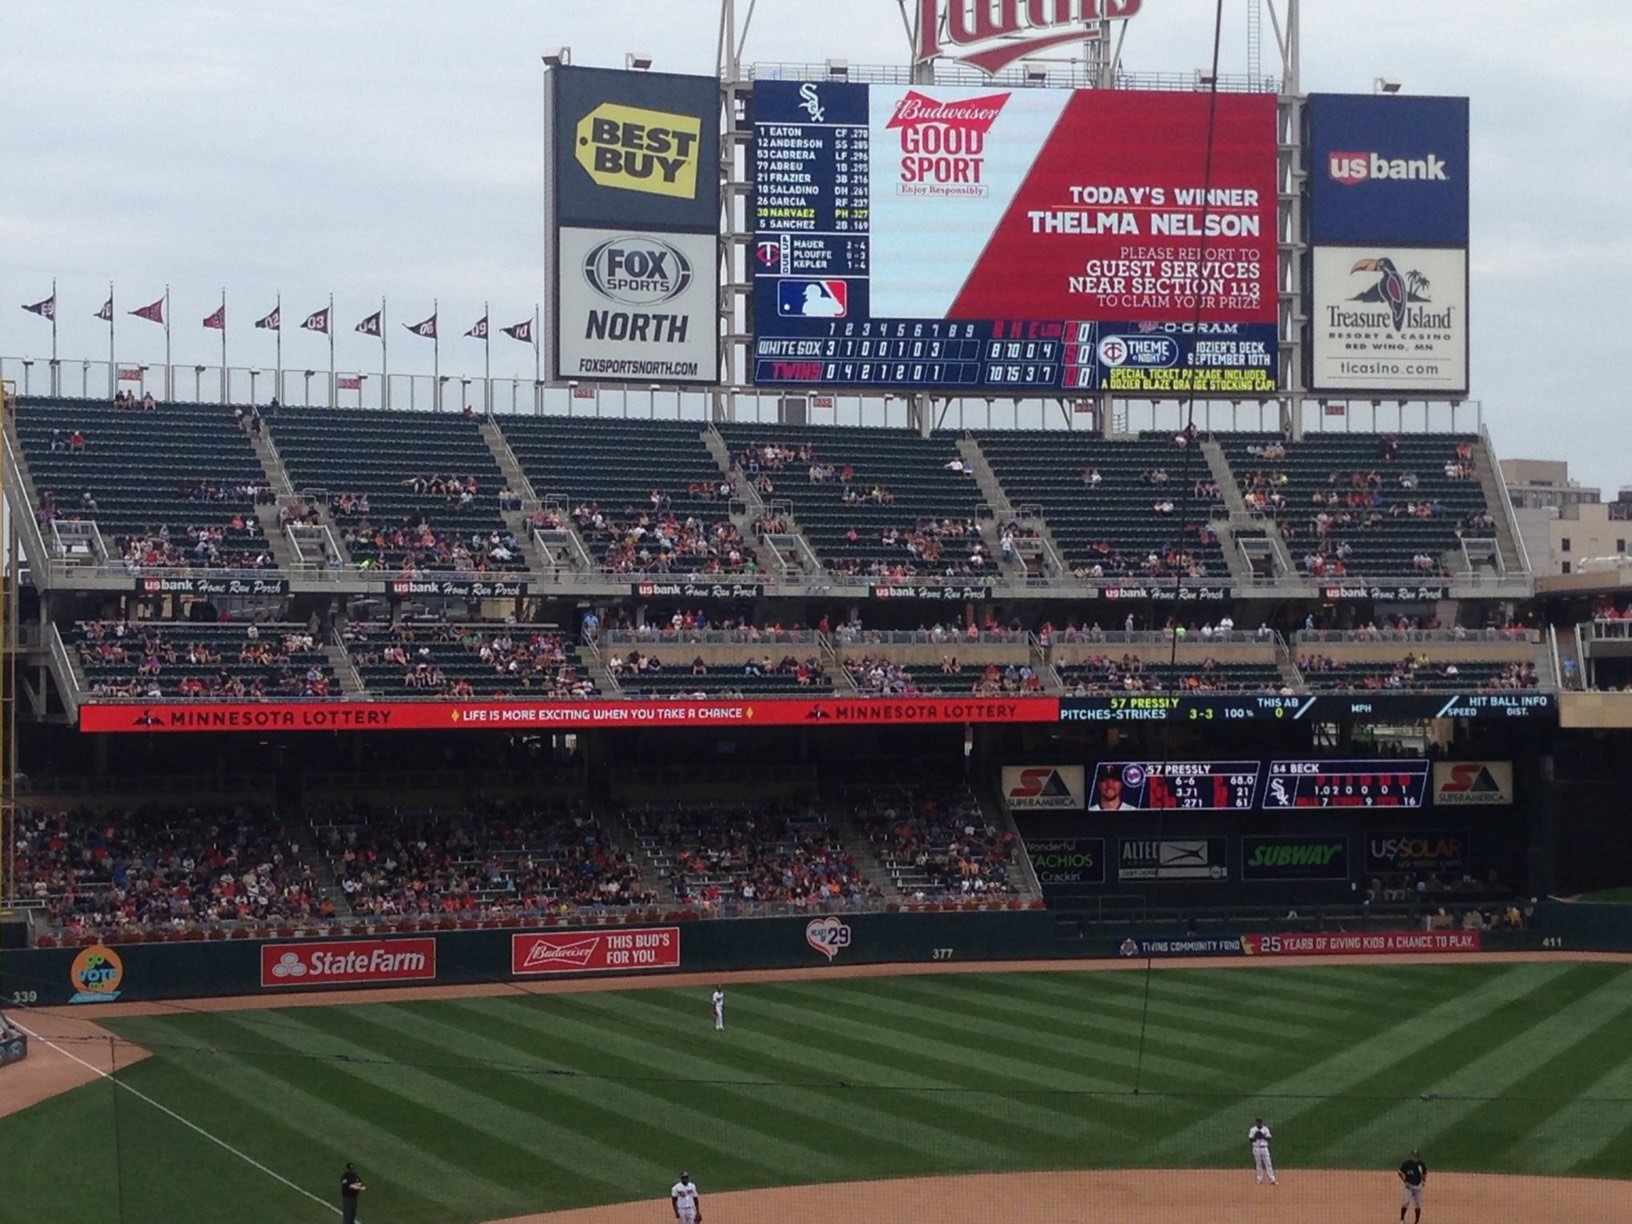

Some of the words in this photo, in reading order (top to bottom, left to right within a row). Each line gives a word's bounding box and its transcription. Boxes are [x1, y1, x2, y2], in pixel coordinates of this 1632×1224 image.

[895, 99, 999, 120] Budweiser
[591, 117, 697, 158] BEST
[769, 127, 802, 137] EATON
[769, 138, 823, 148] ANDERSON
[900, 125, 984, 155] GOOD
[769, 150, 816, 160] CABRERA
[593, 145, 686, 184] BUY
[769, 162, 803, 171] ABREU
[900, 156, 984, 183] SPORT
[769, 173, 811, 182] FRAZIER
[769, 185, 819, 195] SALADINO
[901, 185, 926, 195] Enjoy
[929, 185, 983, 196] Responsibly
[1069, 186, 1165, 205] TODAY'S
[1174, 189, 1258, 206] WINNER
[769, 197, 807, 206] GARCIA
[769, 208, 815, 218] NARVAEZ
[769, 220, 815, 229] SANCHEZ
[1027, 211, 1139, 235] THELMA
[1150, 213, 1260, 237] NELSON
[793, 240, 825, 249] MAUER
[793, 250, 832, 259] PLOUFFE
[1120, 247, 1174, 260] PLEASE
[1239, 248, 1260, 261] TO
[606, 248, 669, 281] FOX
[793, 260, 828, 268] KEPLER
[1086, 260, 1154, 277] GUEST
[1160, 261, 1260, 278] SERVICES
[606, 278, 670, 293] SPORTS
[1068, 277, 1126, 293] NEAR
[1132, 278, 1224, 295] SECTION
[1230, 282, 1260, 298] 113
[1097, 294, 1117, 308] TO
[1121, 295, 1170, 308] CLAIM
[1219, 296, 1260, 309] PRIZE
[307, 316, 325, 329] 03
[1326, 305, 1391, 329] Treasure
[1406, 307, 1452, 330] Island
[419, 321, 434, 335] 06
[471, 322, 487, 336] 09
[585, 309, 689, 344] NORTH
[1328, 332, 1379, 340] RESORT
[1400, 333, 1452, 341] CASINO
[758, 341, 796, 355] WHITE
[797, 340, 822, 356] SOX
[1006, 343, 1021, 358] 10
[1127, 341, 1170, 356] THEME
[1239, 342, 1265, 354] DECK
[1345, 343, 1368, 351] RED
[1414, 344, 1433, 352] MN
[1138, 353, 1161, 363] NIGHT
[1187, 353, 1245, 366] SEPTEMBER
[1247, 353, 1271, 366] 10TH
[579, 358, 698, 378] FOXSPORTSNORTH.COM
[990, 366, 1003, 381] 10
[1006, 366, 1021, 381] 15
[1109, 368, 1147, 380] SPECIAL
[1150, 368, 1180, 380] TICKET
[1224, 369, 1267, 380] INCLUDES
[1340, 361, 1439, 375] ticasino.com
[1101, 379, 1108, 389] A
[1110, 379, 1141, 390] DOZIER
[1143, 379, 1171, 390] BLAZE
[1209, 380, 1253, 391] STOCKING
[196, 580, 226, 593] Home
[253, 580, 281, 594] Porch
[1111, 698, 1125, 708] 57
[1130, 698, 1180, 708] PRESSLY
[1257, 698, 1282, 708] THIS
[1283, 698, 1299, 708] AB
[1469, 696, 1487, 706] HIT
[1490, 696, 1517, 706] BALL
[1520, 696, 1548, 706] INFO
[171, 711, 295, 726] MINNESOTA
[302, 710, 392, 724] LOTTERY
[463, 710, 487, 722] LIFE
[489, 710, 500, 721] IS
[502, 710, 537, 721] MORE
[538, 709, 590, 720] EXCITING
[593, 708, 628, 720] WHEN
[631, 708, 655, 720] YOU
[657, 708, 686, 719] TAKE
[688, 708, 695, 719] A
[698, 708, 743, 719] CHANCE
[835, 706, 938, 719] MINNESOTA
[944, 704, 1018, 718] LOTTERY
[1060, 709, 1167, 720] PITCHES-STRIKES
[1275, 708, 1283, 718] 0
[1351, 704, 1372, 714] MPH
[1446, 707, 1477, 717] SPEED
[1165, 765, 1211, 776] PRESSLY
[1272, 764, 1287, 773] 54
[1290, 763, 1320, 774] BECK
[1247, 844, 1343, 866] SUBWAY
[606, 935, 634, 949] THIS
[635, 933, 671, 948] BUD'S
[828, 927, 849, 945] 29
[1542, 937, 1563, 947] 411
[1170, 940, 1218, 952] COMMUNITY
[1219, 939, 1241, 951] FUND
[1260, 937, 1281, 952] 25
[1283, 938, 1313, 951] YEARS
[1315, 938, 1328, 950] OF
[1330, 937, 1361, 949] GIVING
[1363, 937, 1385, 948] KIDS
[1387, 937, 1394, 948] A
[1396, 936, 1433, 948] CHANCE
[1435, 936, 1447, 948] TO
[1449, 936, 1474, 948] PLAY.
[531, 945, 593, 961] Budweiser
[606, 950, 629, 964] FOR
[631, 949, 656, 964] YOU
[932, 948, 954, 960] 377
[78, 968, 117, 982] VOTE
[13, 990, 38, 1003] 339
